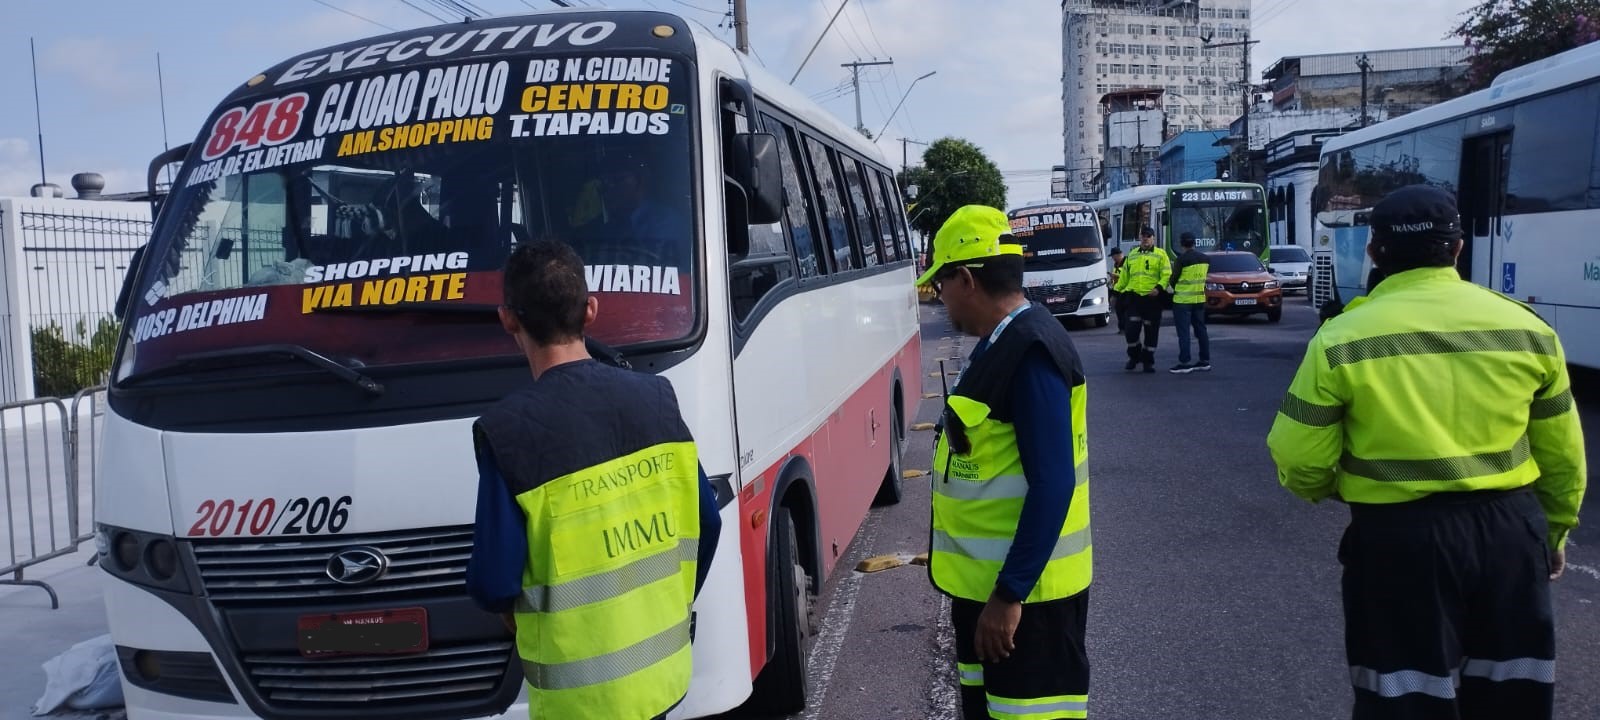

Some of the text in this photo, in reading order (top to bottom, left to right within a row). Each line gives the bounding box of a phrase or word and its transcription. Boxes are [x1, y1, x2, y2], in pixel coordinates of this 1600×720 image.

[273, 21, 617, 86] EXECUTIVO
[525, 57, 672, 84] DB N.CIDADE
[417, 60, 510, 121] PAULO
[520, 83, 669, 112] CENTRO
[201, 92, 309, 161] 848
[337, 116, 493, 157] AM.SHOPPING
[509, 111, 670, 138] T.TAPAJOS
[185, 138, 326, 188] AREA DE EX.DETRAN
[1182, 192, 1198, 201] 223
[1214, 191, 1246, 200] BATISTA
[1029, 213, 1064, 227] B.DA
[1065, 212, 1093, 226] PAZ
[1195, 239, 1215, 247] ENTRO
[303, 251, 469, 284] SHOPPING
[584, 264, 681, 295] VIARIA
[1583, 261, 1600, 281] Ma
[301, 272, 467, 315] VIA NORTE
[133, 293, 268, 345] HOSP. DELPHINA
[568, 452, 675, 501] TRANSPORTE
[187, 495, 353, 537] 2010/206
[602, 511, 676, 559] IMMU
